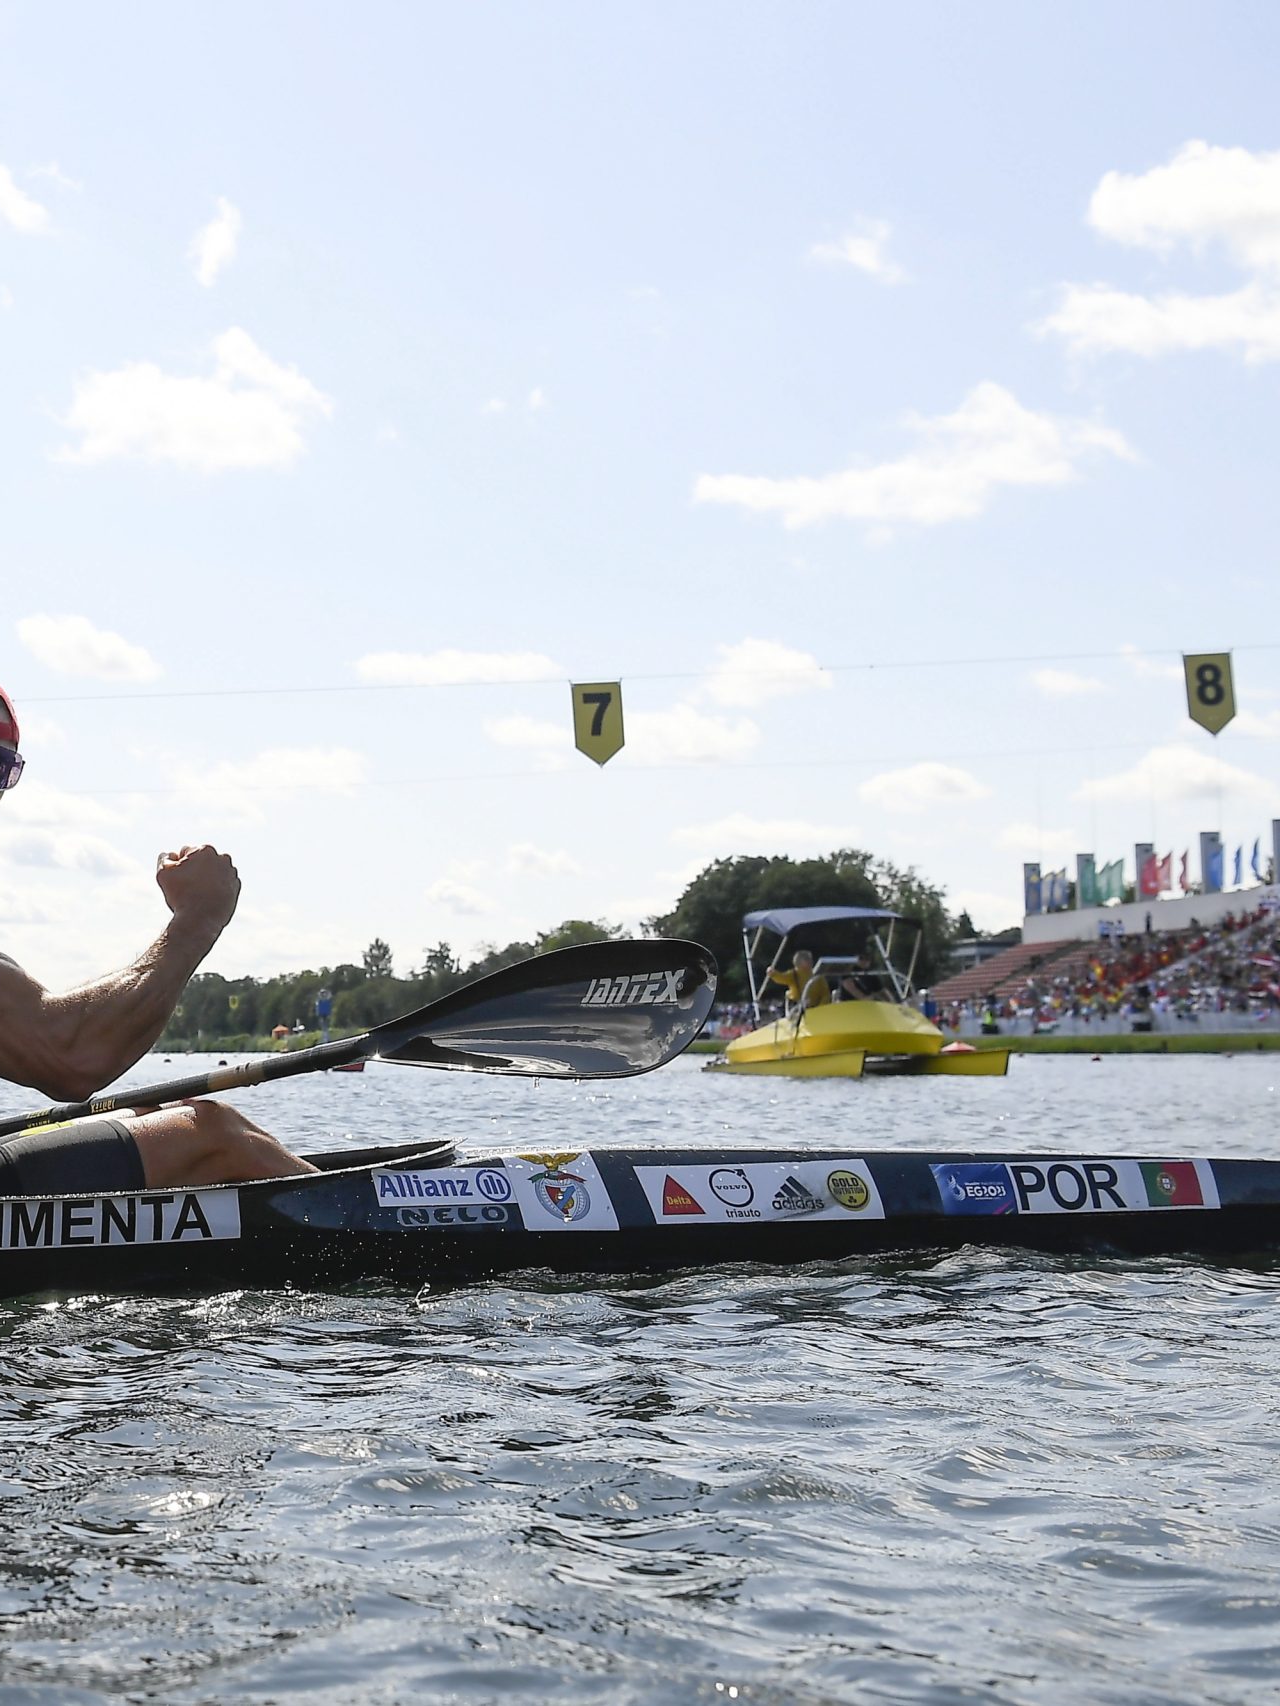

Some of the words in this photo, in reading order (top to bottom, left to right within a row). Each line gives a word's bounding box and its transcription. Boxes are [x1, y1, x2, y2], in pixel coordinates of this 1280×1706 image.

[1196, 664, 1224, 706] 8
[582, 692, 612, 736] 7
[378, 1174, 474, 1198] Allianz
[832, 1178, 859, 1187] GOLD
[1010, 1163, 1127, 1211] POR
[666, 1196, 692, 1206] Delta
[772, 1198, 825, 1211] adidas
[400, 1206, 506, 1226] NELO
[725, 1208, 761, 1219] triauto
